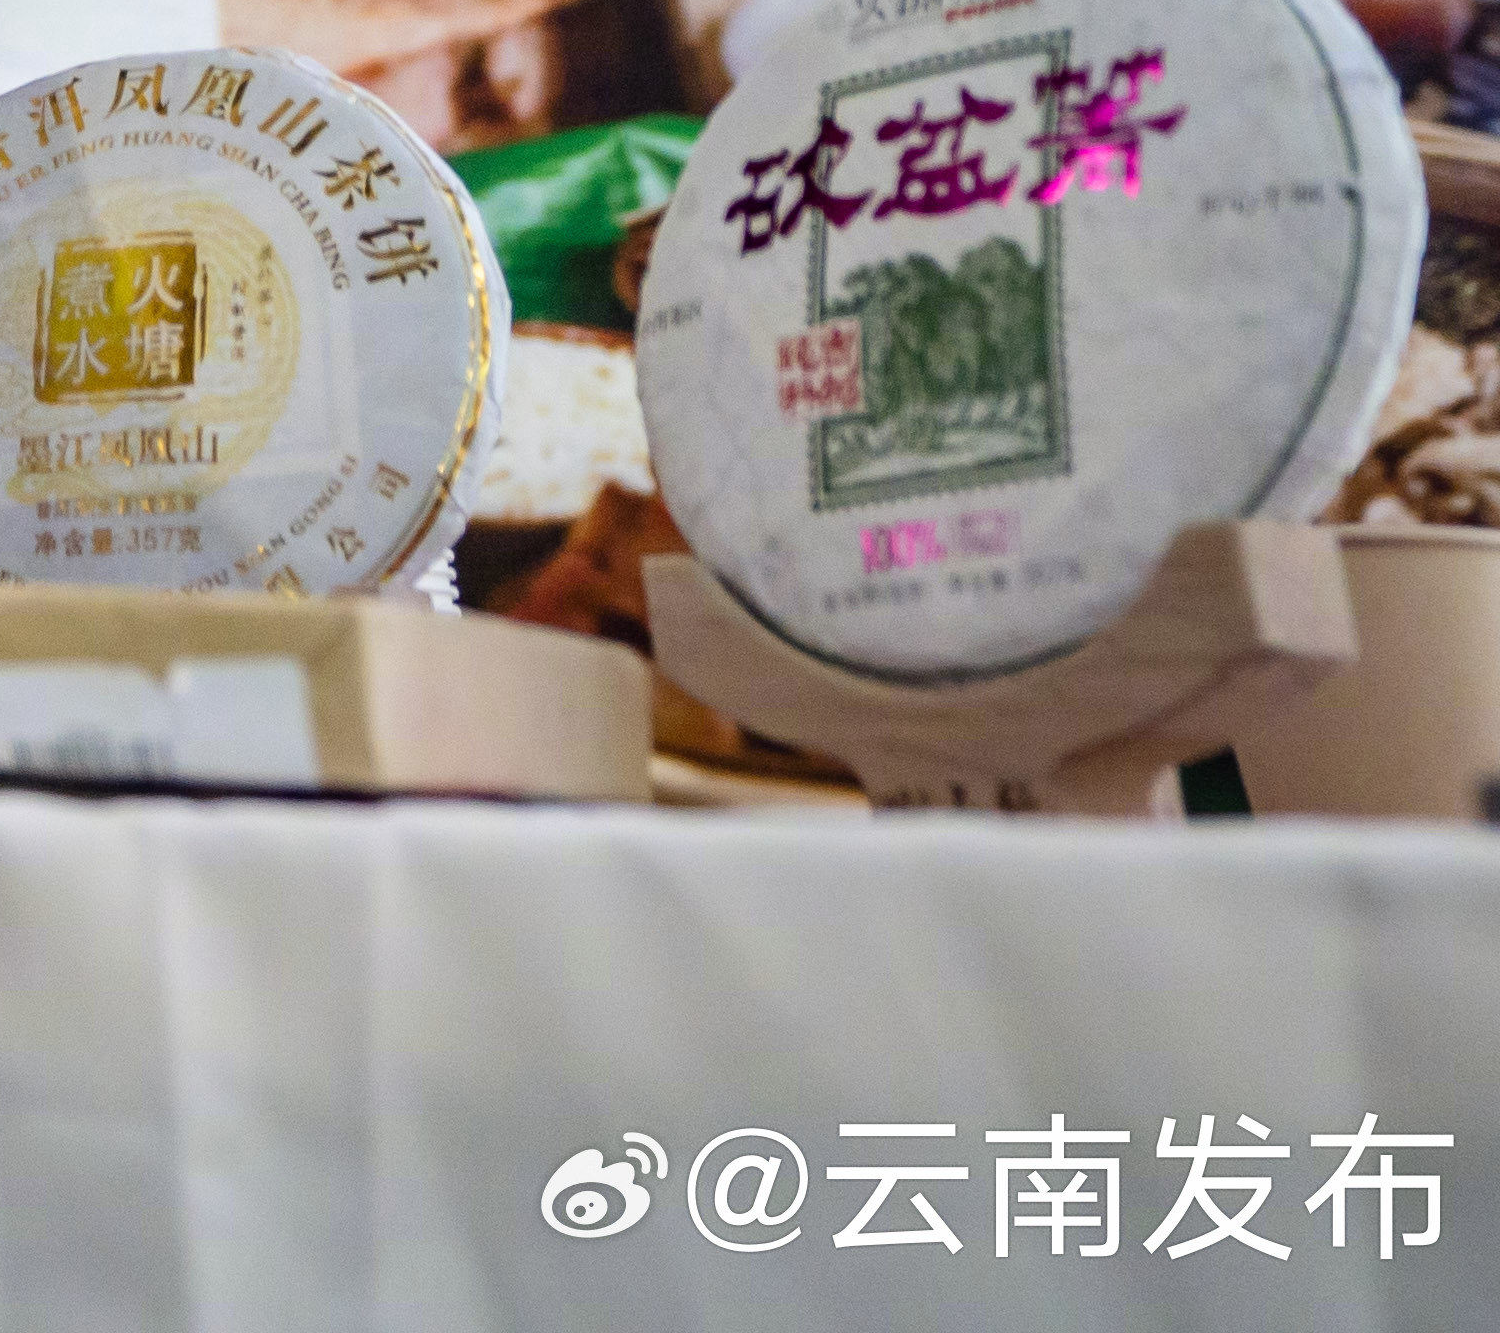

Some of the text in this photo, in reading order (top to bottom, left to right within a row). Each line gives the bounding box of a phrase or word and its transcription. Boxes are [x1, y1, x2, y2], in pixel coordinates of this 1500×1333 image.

[15, 165, 46, 190] ER
[52, 134, 114, 169] FENG
[123, 130, 213, 152] HUANG
[216, 142, 281, 183] SHAN
[279, 180, 321, 227] CHA
[313, 227, 350, 292] BING
[56, 261, 115, 385] 煮水
[122, 253, 185, 382] 火塘
[17, 424, 219, 474] 墨江凤凰山
